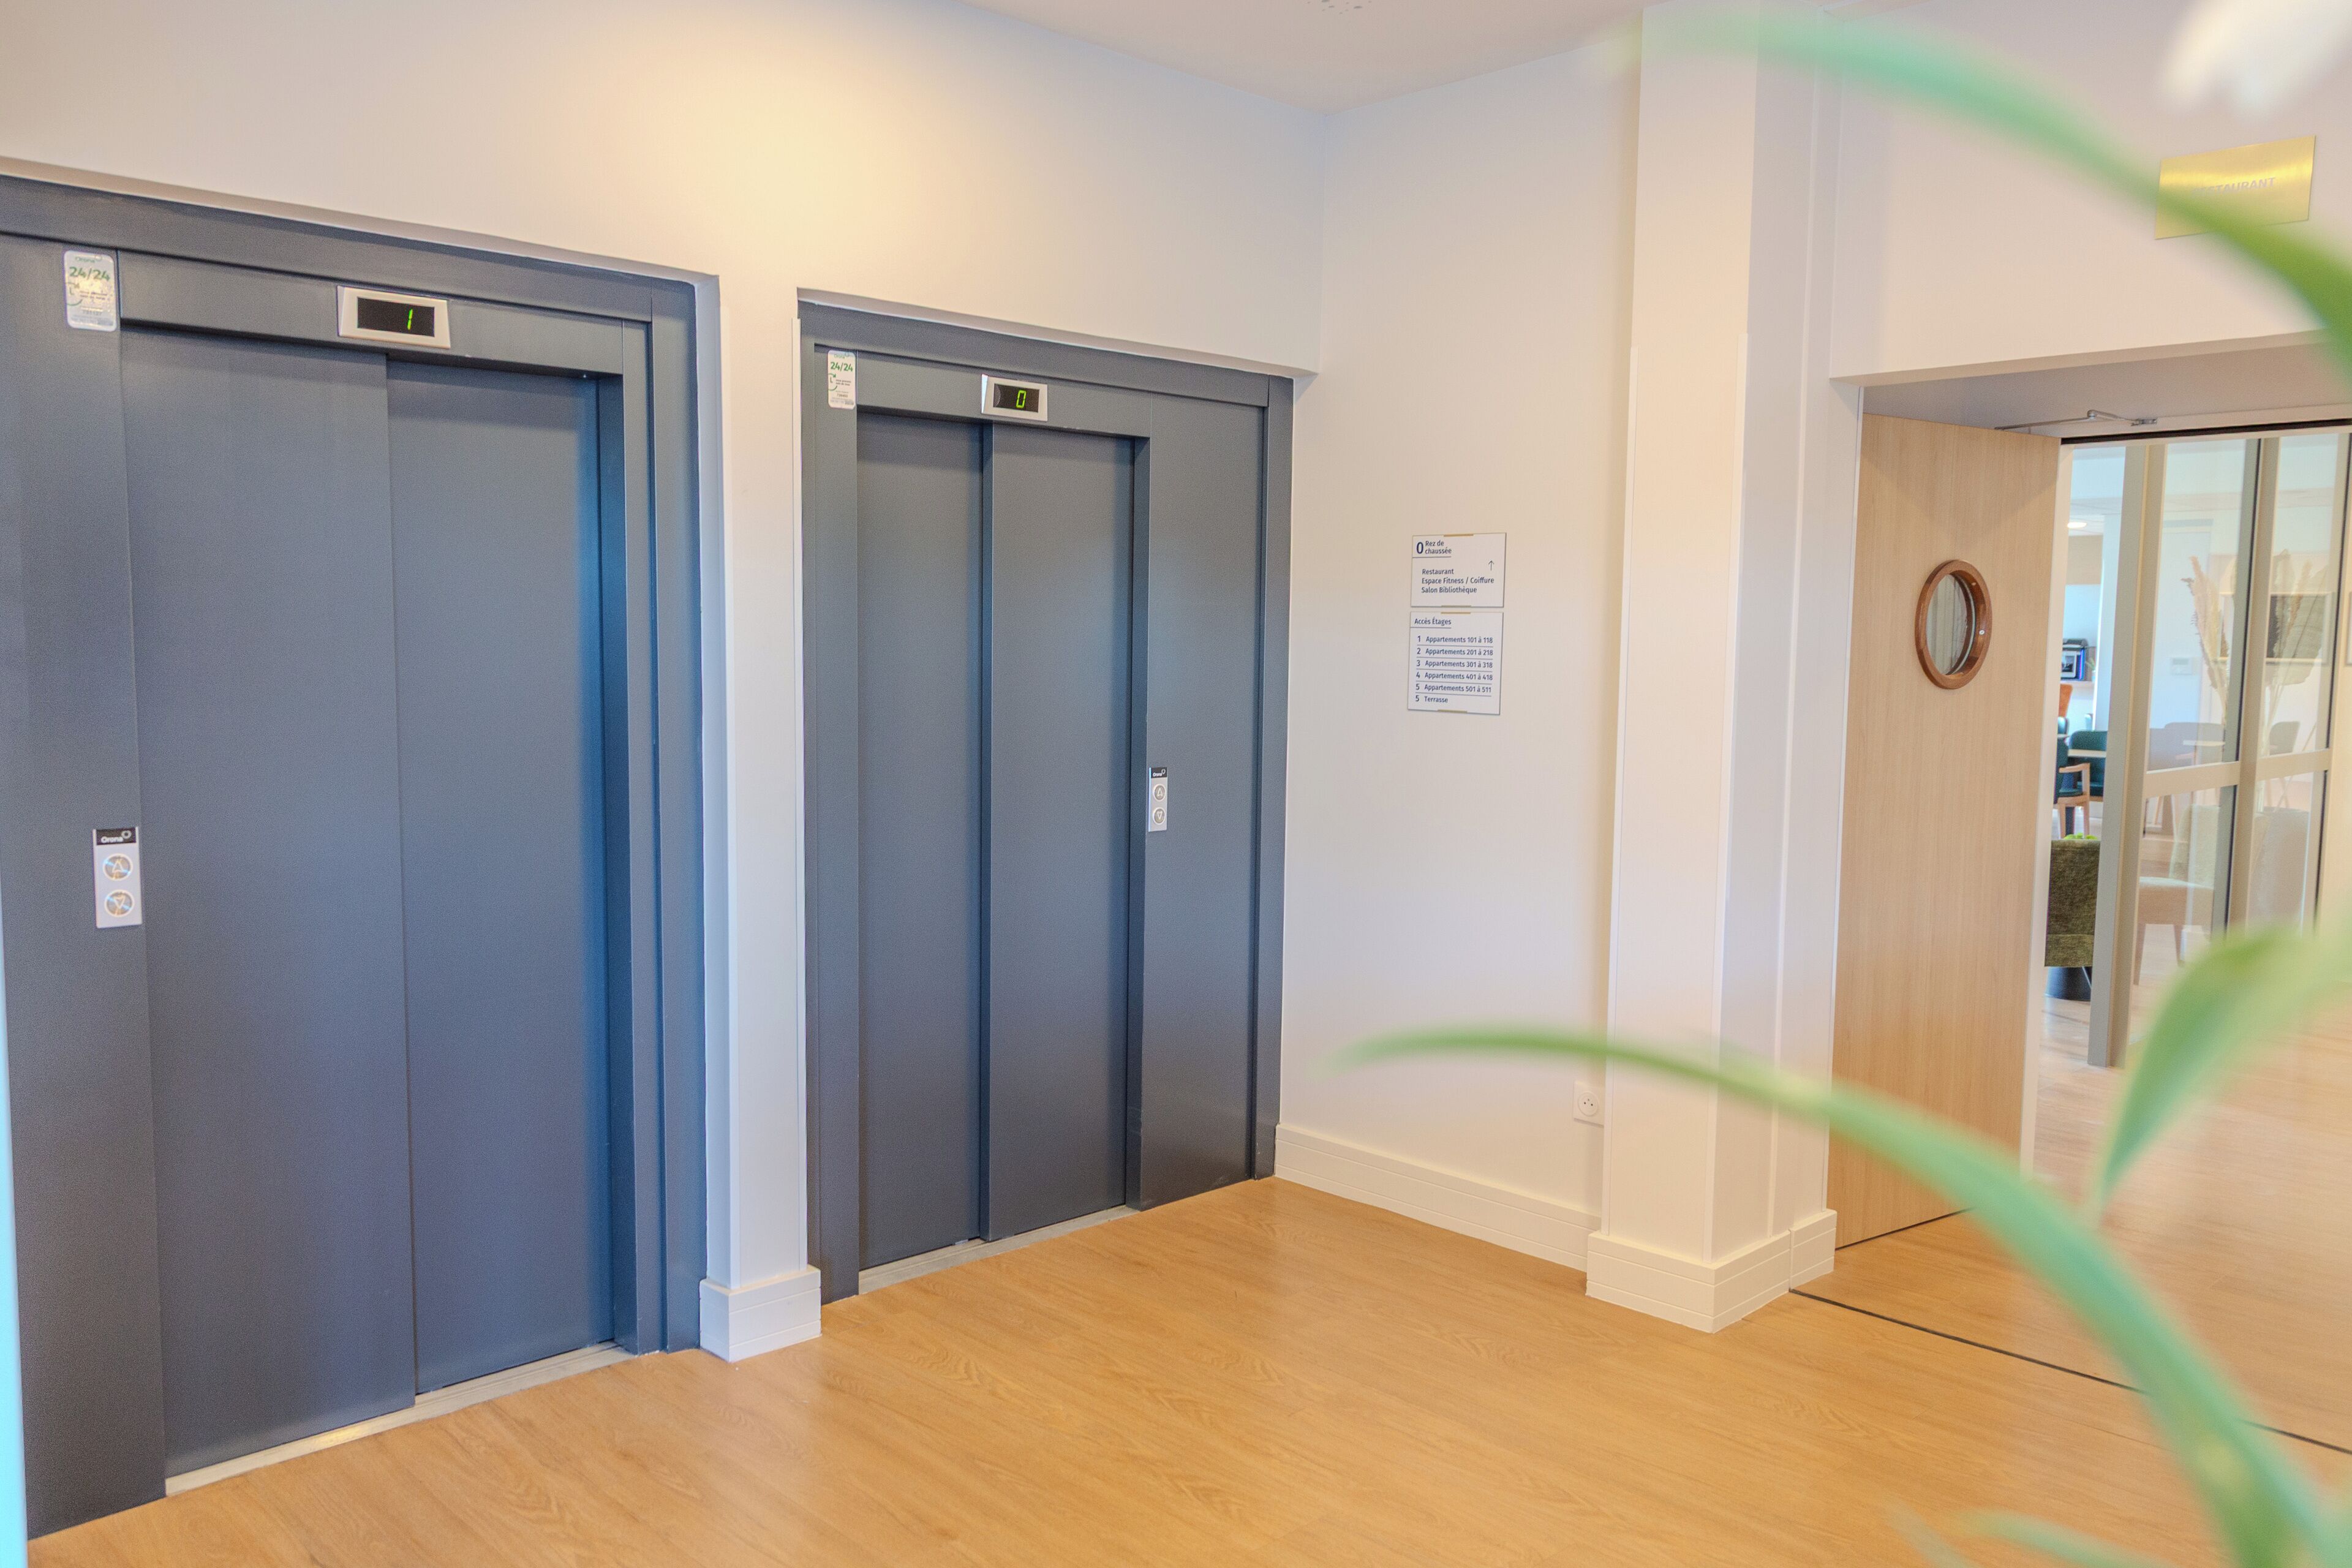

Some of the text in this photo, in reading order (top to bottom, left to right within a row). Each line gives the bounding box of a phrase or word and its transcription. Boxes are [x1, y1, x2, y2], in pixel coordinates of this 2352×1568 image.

[2192, 177, 2275, 195] STAURANT
[69, 266, 110, 281] 24/24
[407, 308, 413, 330] 1
[831, 362, 853, 372] 24/24
[1016, 390, 1027, 408] 0
[1416, 542, 1423, 554] 0
[1432, 617, 1451, 626] Étages
